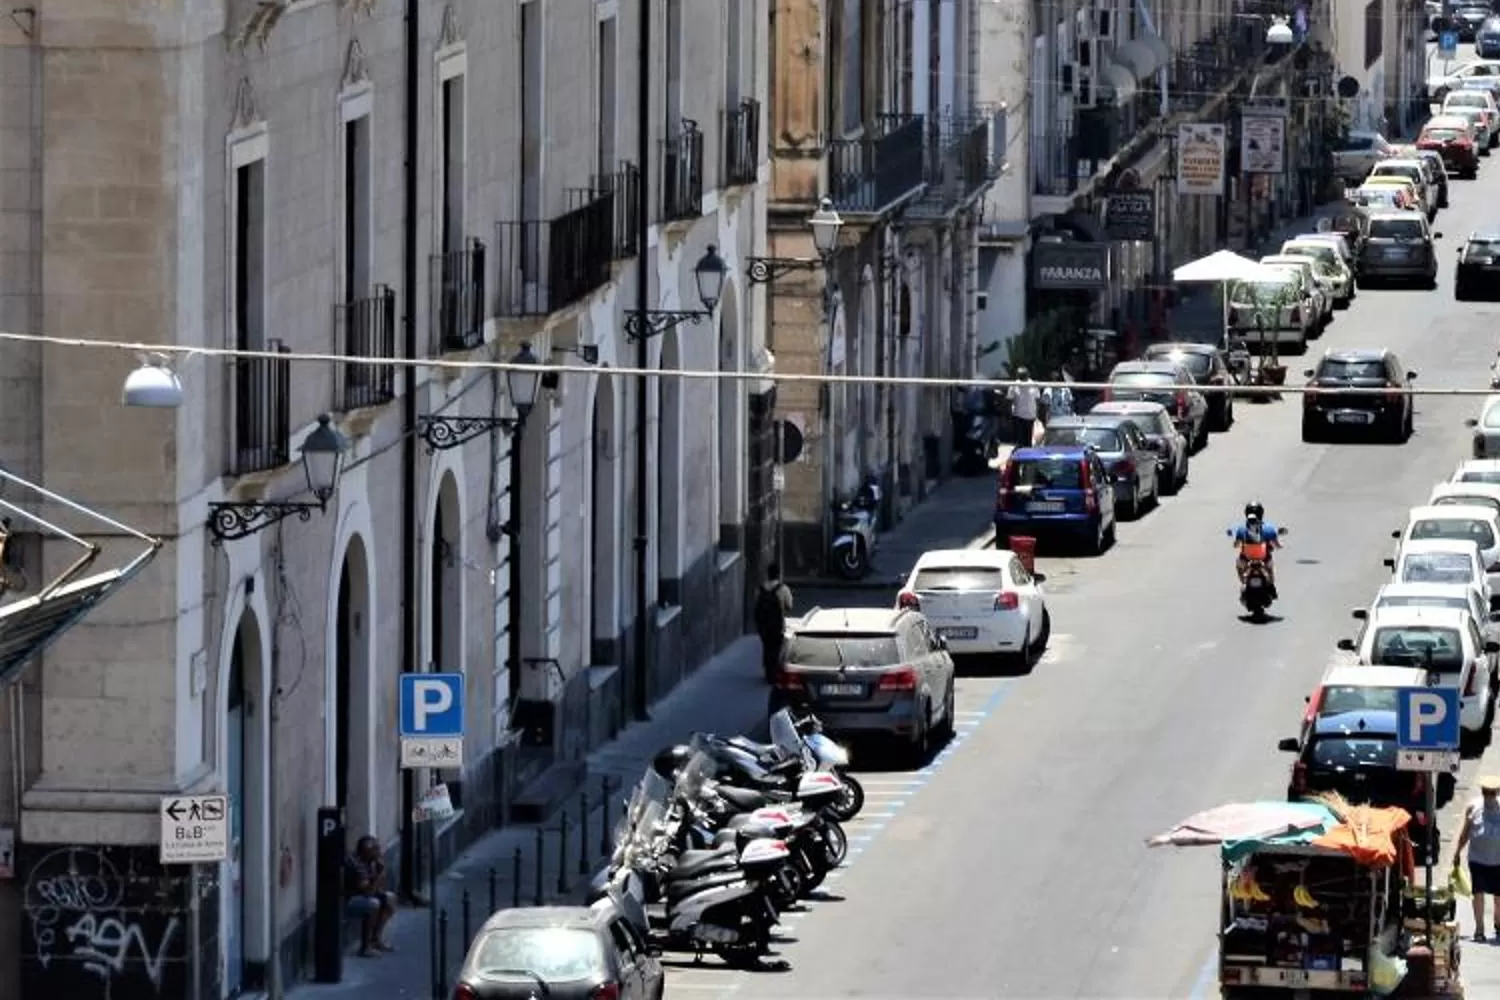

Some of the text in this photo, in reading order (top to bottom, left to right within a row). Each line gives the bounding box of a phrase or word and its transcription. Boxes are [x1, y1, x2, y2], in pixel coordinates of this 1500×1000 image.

[413, 680, 453, 731] P
[1409, 692, 1447, 742] P
[323, 818, 336, 837] P
